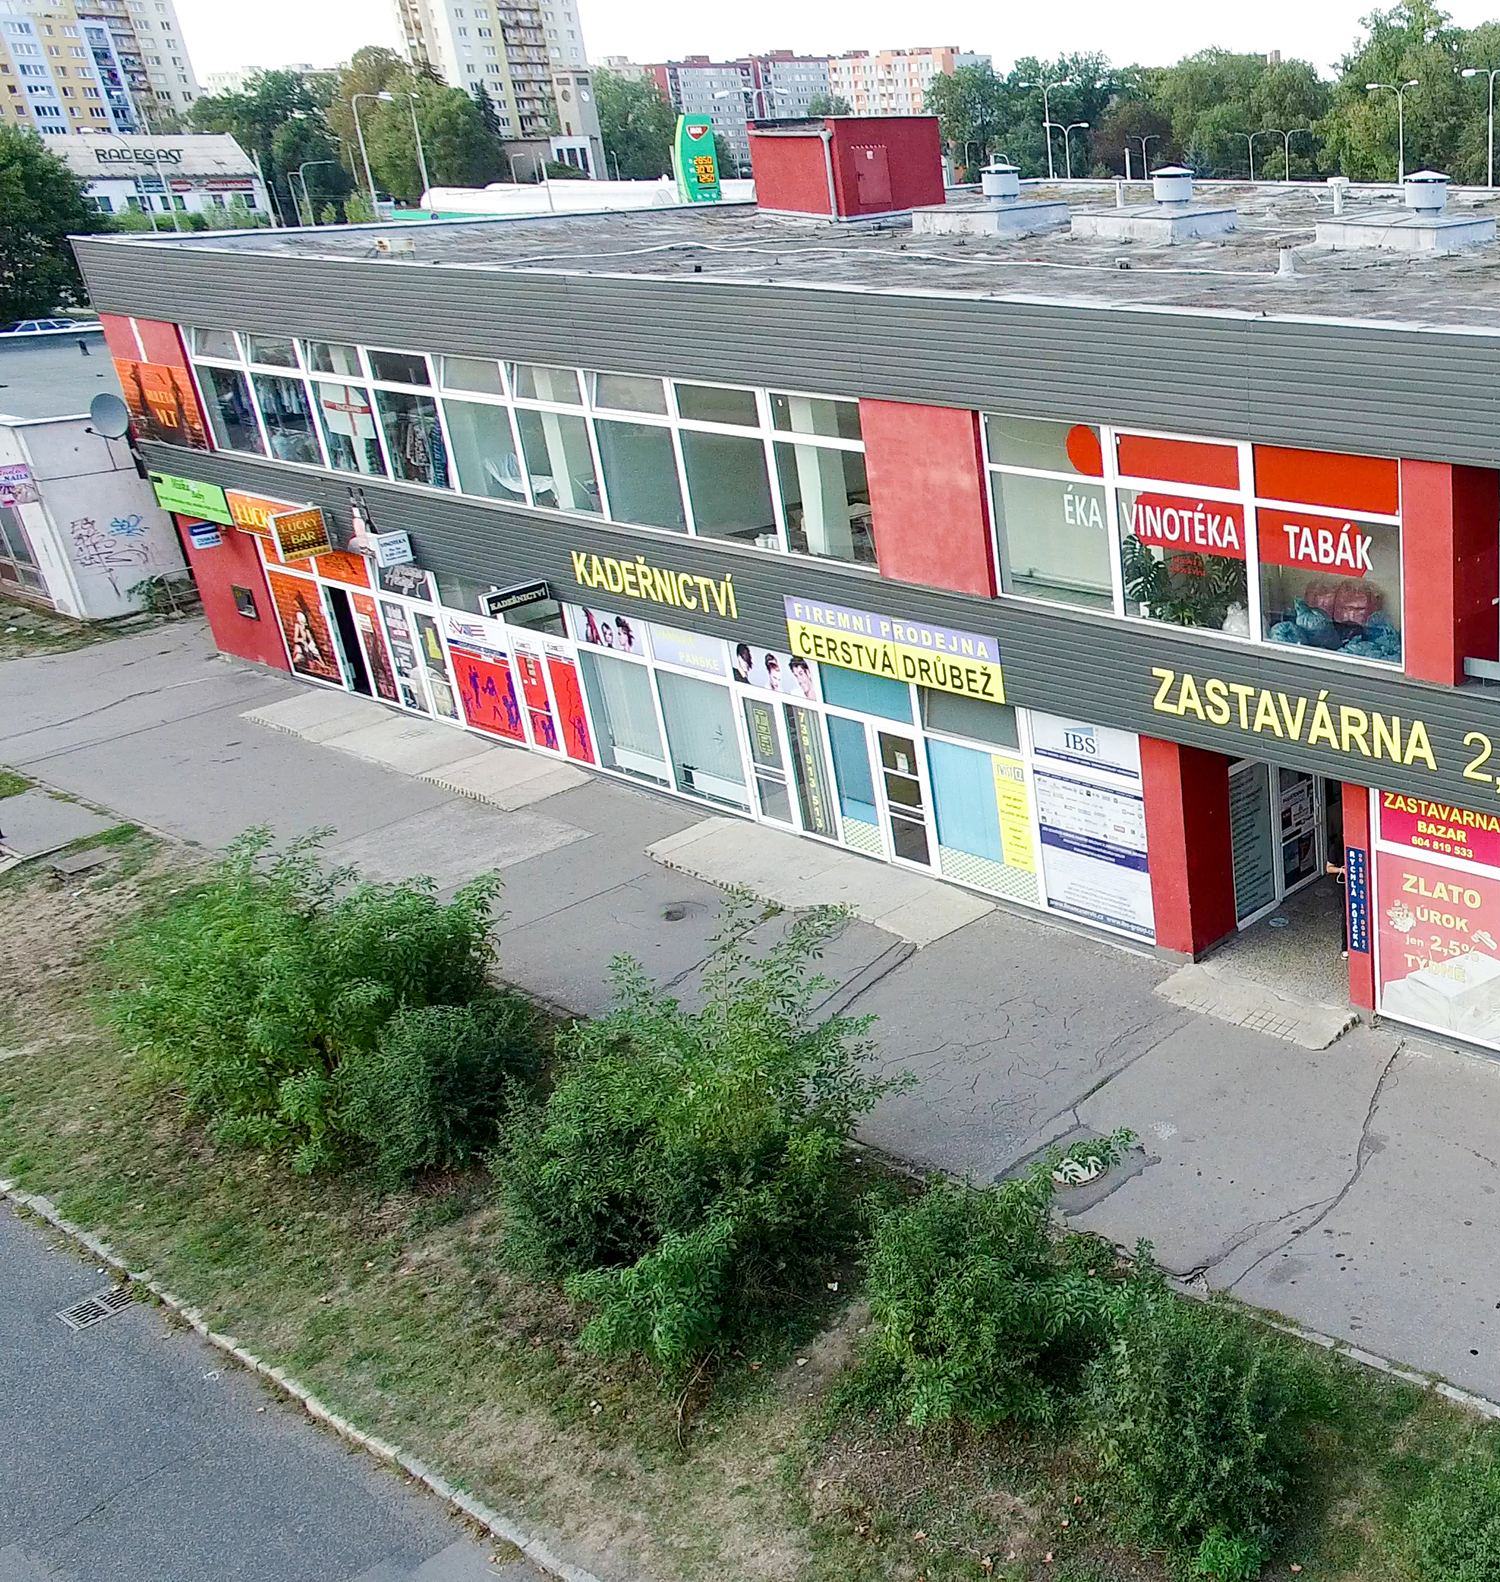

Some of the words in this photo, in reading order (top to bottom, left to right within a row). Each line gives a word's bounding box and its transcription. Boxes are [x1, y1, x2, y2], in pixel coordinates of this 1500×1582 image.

[95, 149, 183, 164] RADEGAST
[4, 473, 29, 481] NAILS
[235, 503, 274, 528] LUCK
[1063, 484, 1104, 529] ÉKA
[281, 518, 318, 534] LUCKY
[291, 532, 316, 545] BAR
[1122, 501, 1240, 550] VINOTÉKA
[1283, 523, 1374, 571] TABÁK
[571, 550, 738, 619] KADEŘNICTVÍ
[793, 602, 872, 634] FIREMNÍ
[879, 622, 990, 659] PRODEJNA
[799, 626, 895, 675] ČERSTVÁ
[902, 655, 995, 697] DRŮBEŽ
[1151, 667, 1438, 771] ZASTAVÁRNA
[1064, 731, 1096, 755] IBS
[1417, 820, 1467, 843] BAZAR
[1411, 836, 1430, 848] 604
[1432, 842, 1451, 853] 819
[1454, 847, 1473, 858] 533
[1402, 873, 1482, 909] ZLATO
[1416, 905, 1469, 933] ÚROK
[1405, 934, 1425, 947] jen
